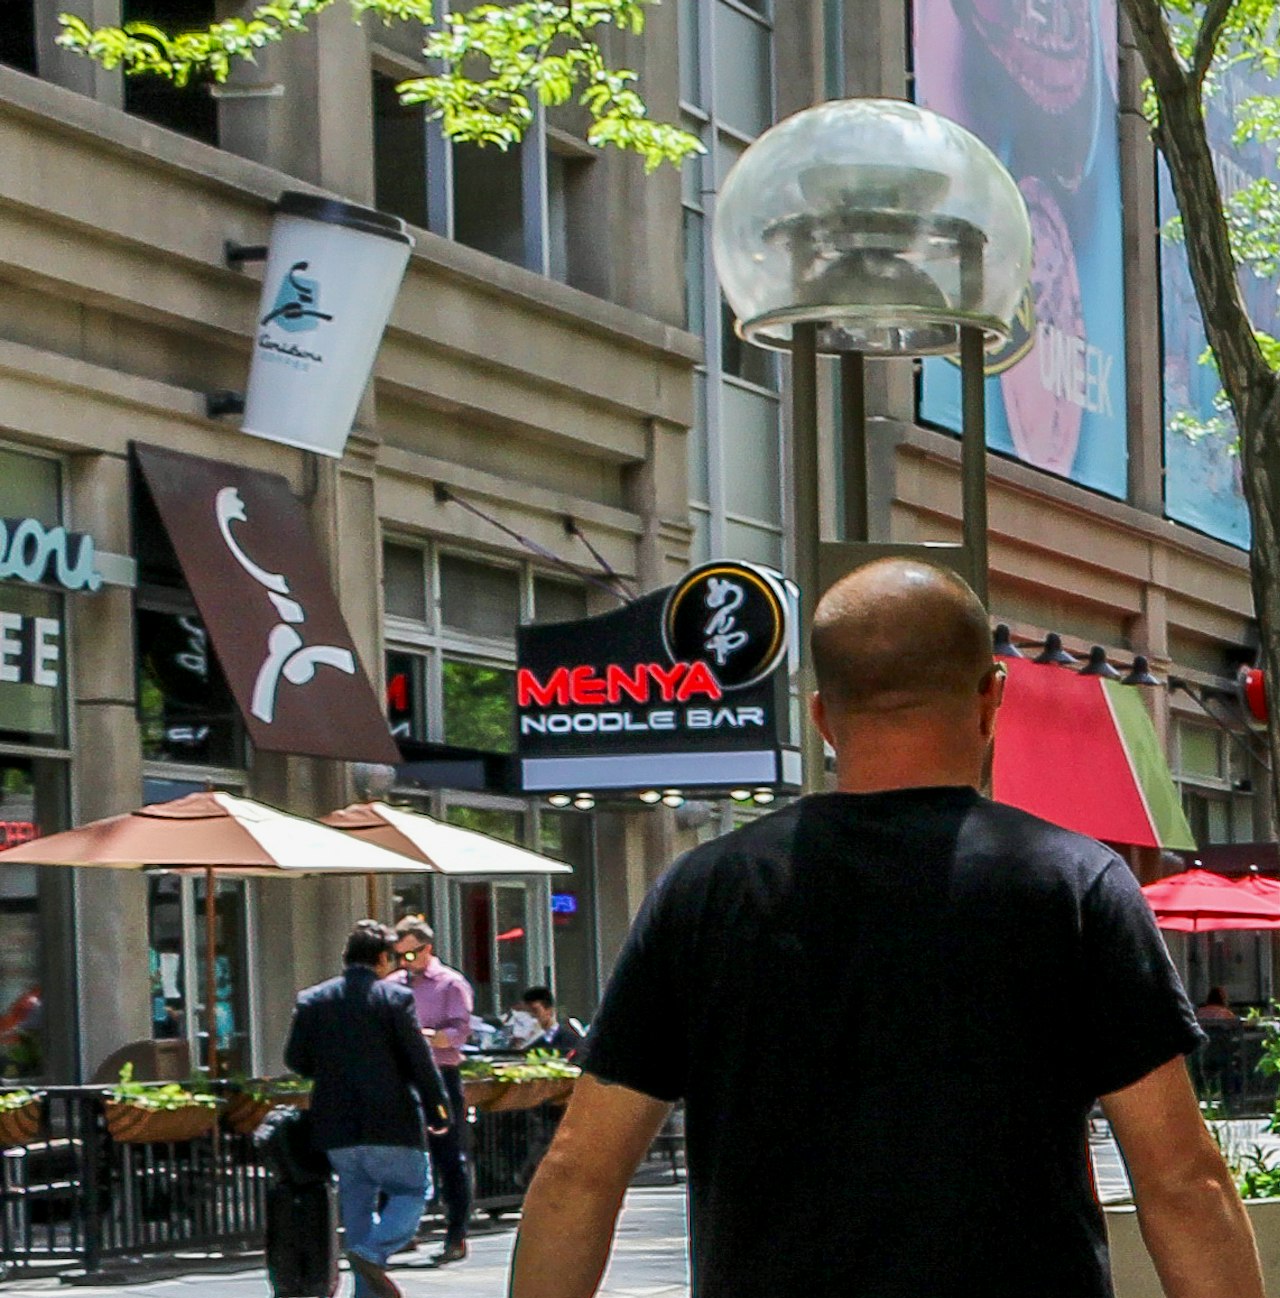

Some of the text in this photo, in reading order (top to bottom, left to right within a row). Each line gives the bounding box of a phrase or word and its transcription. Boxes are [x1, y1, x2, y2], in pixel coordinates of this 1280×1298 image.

[517, 660, 722, 707] MENYA
[520, 706, 764, 735] NOODLE BAR
